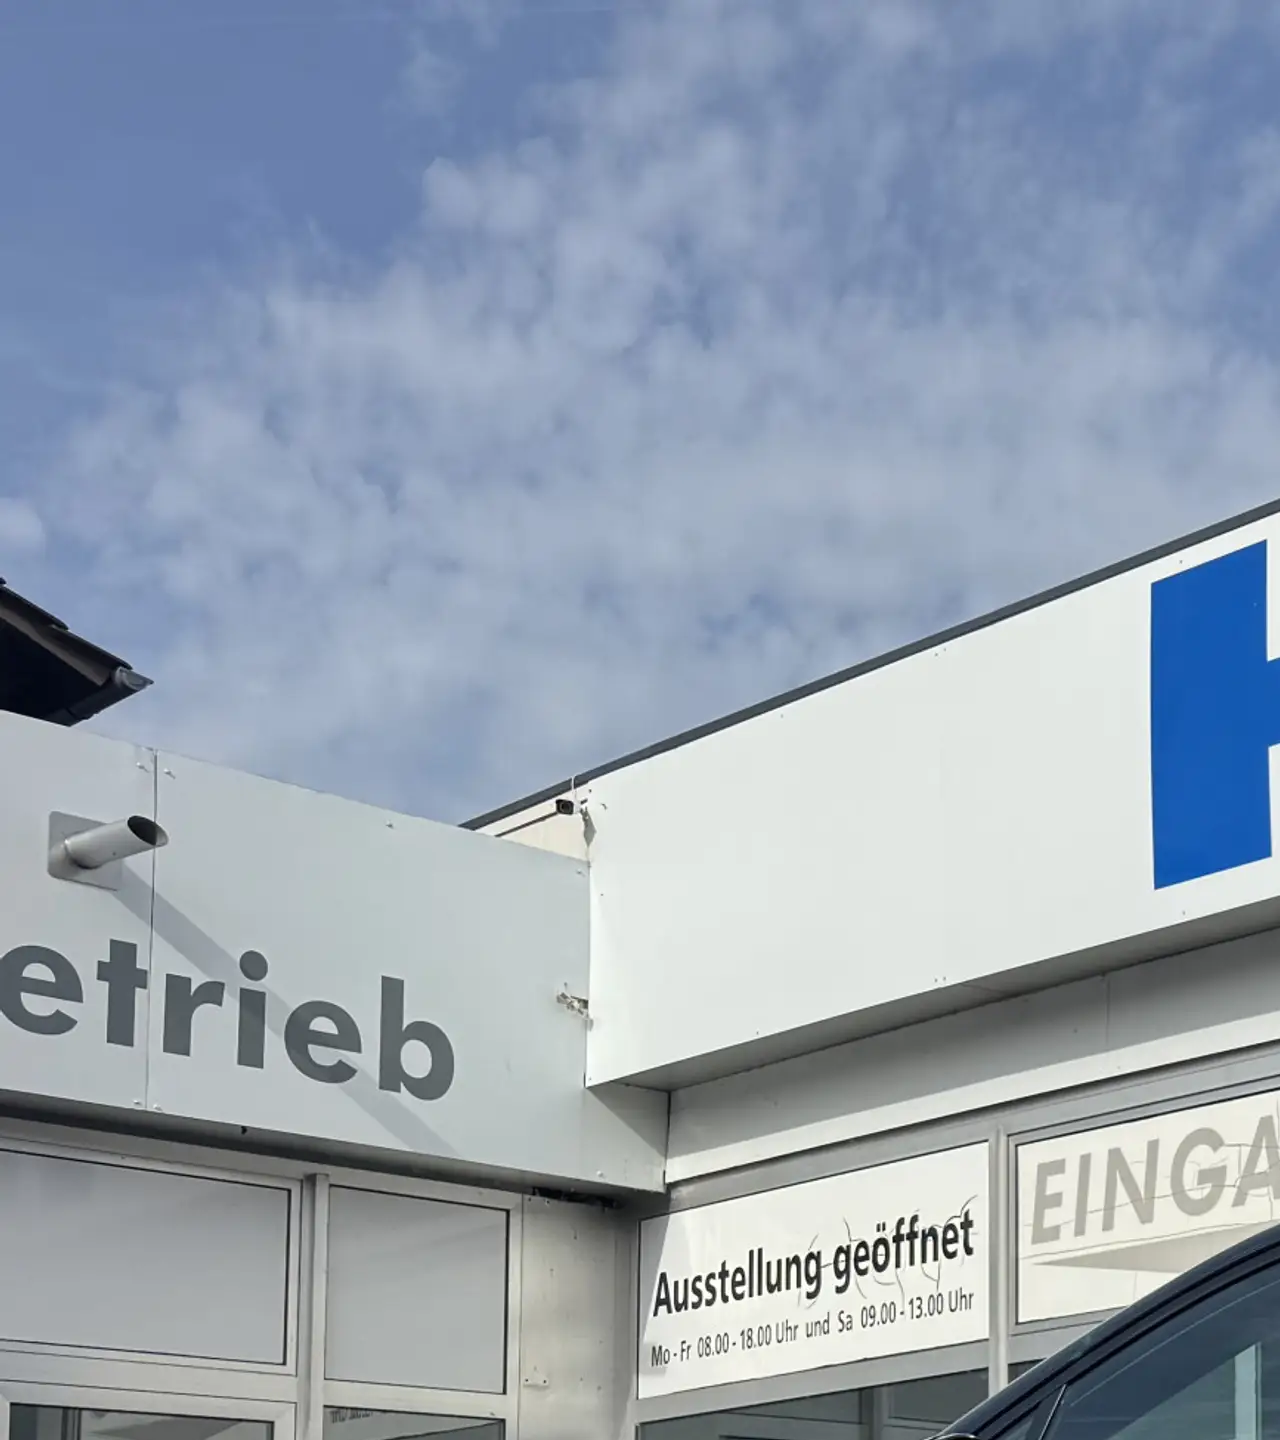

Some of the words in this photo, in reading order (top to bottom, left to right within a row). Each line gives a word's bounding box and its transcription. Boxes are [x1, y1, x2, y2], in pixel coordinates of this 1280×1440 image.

[0, 937, 455, 1102] etrieb
[653, 1247, 822, 1317] Ausstellung
[832, 1209, 974, 1293] geöffnet
[651, 1345, 671, 1367] Mo
[680, 1340, 692, 1362] Fr
[697, 1333, 730, 1359] 08.00
[740, 1325, 772, 1351] 18.00
[776, 1320, 799, 1344] Uhr
[805, 1312, 830, 1338] und
[838, 1309, 854, 1334] Sa
[860, 1301, 897, 1328] 09.00
[909, 1293, 944, 1321] 13.00
[948, 1287, 974, 1314] Uhr
